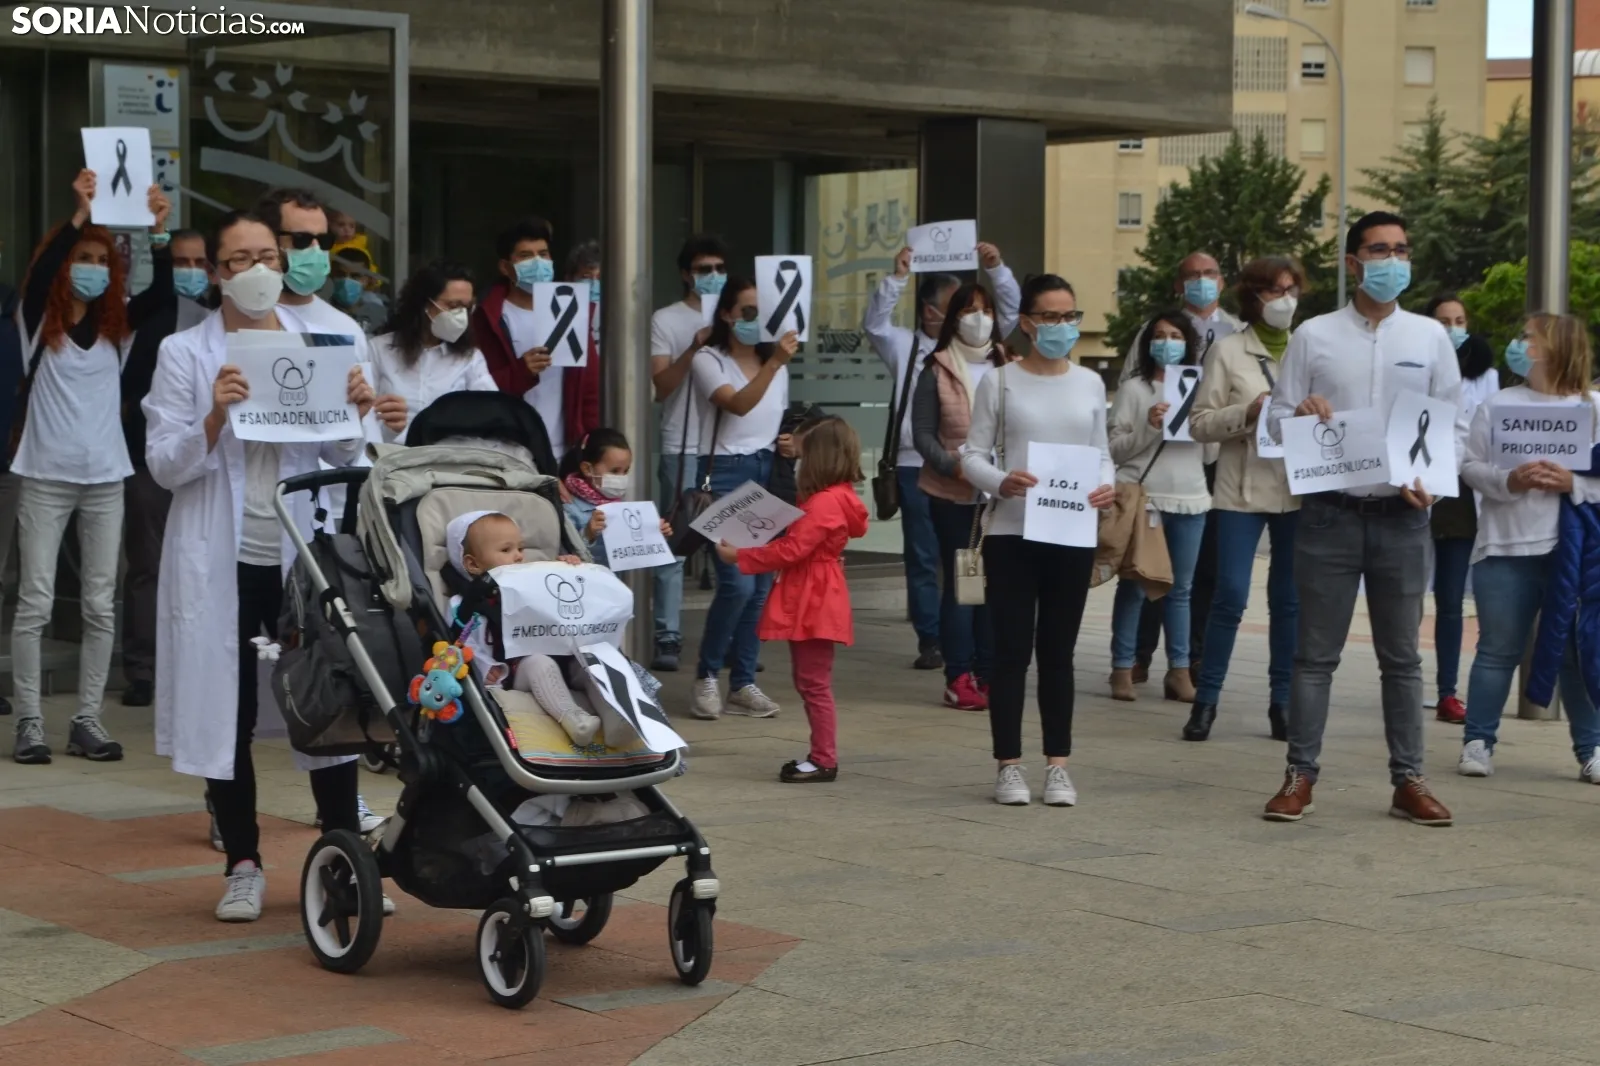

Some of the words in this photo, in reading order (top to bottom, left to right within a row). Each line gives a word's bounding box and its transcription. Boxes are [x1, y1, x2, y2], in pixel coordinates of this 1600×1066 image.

[239, 409, 350, 425] #SANIDADENLUCHA
[1501, 418, 1577, 432] SANIDAD
[1501, 443, 1577, 455] PRIORIDAD
[1294, 457, 1381, 480] #SANIDADENLUCHA
[1049, 478, 1078, 490] S.O.S
[1037, 497, 1085, 512] SANIDAD
[511, 622, 620, 638] #MEDICOSDICENBASTA
